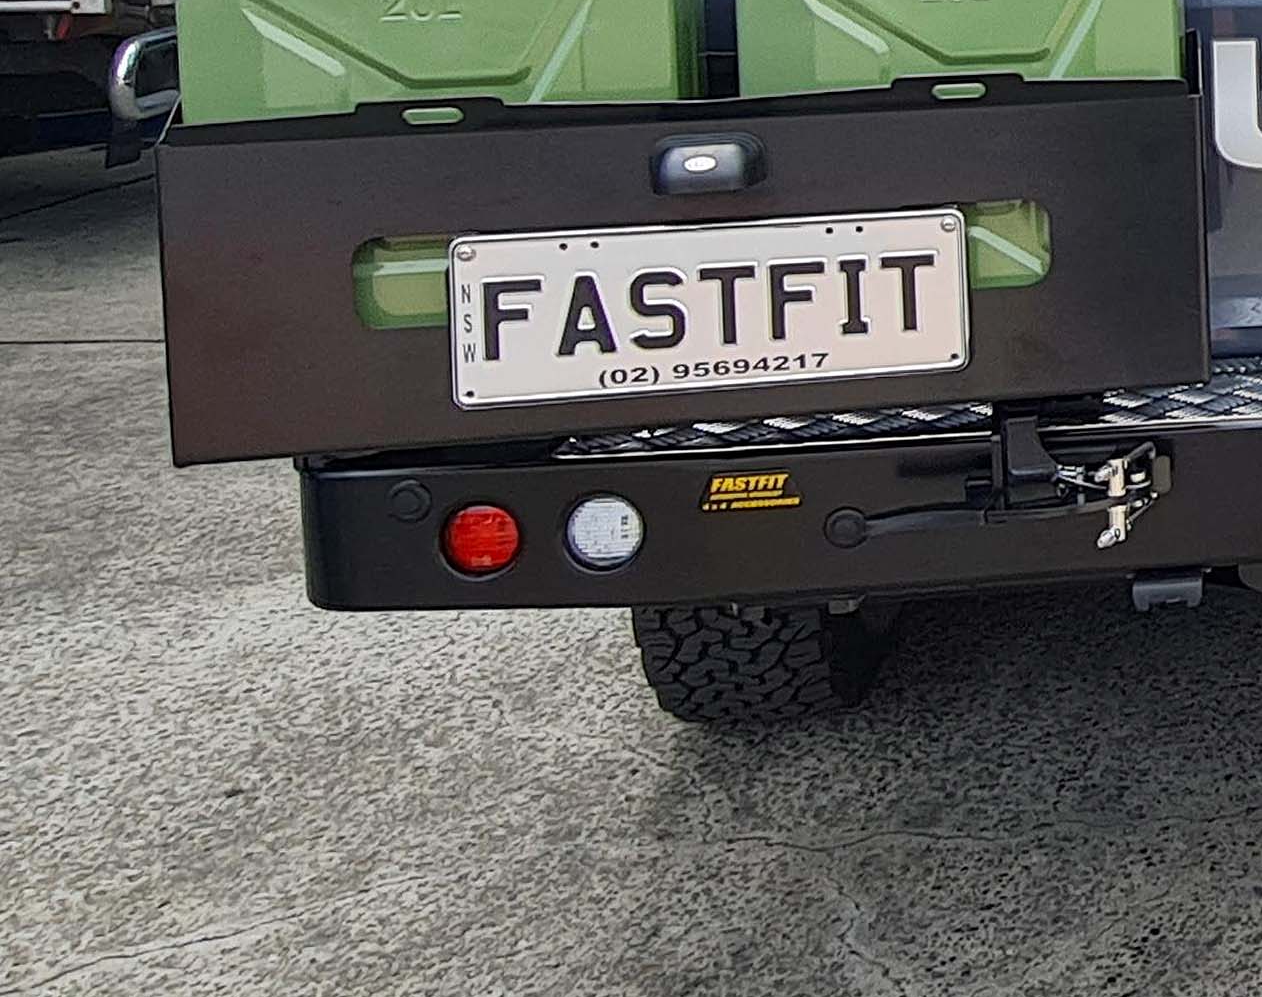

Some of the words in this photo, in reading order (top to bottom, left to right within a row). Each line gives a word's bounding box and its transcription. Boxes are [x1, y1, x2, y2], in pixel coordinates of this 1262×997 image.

[481, 251, 937, 361] FASTFIT
[599, 367, 660, 388] (02)
[672, 353, 829, 380] 95694217
[710, 474, 789, 493] FASTFIT
